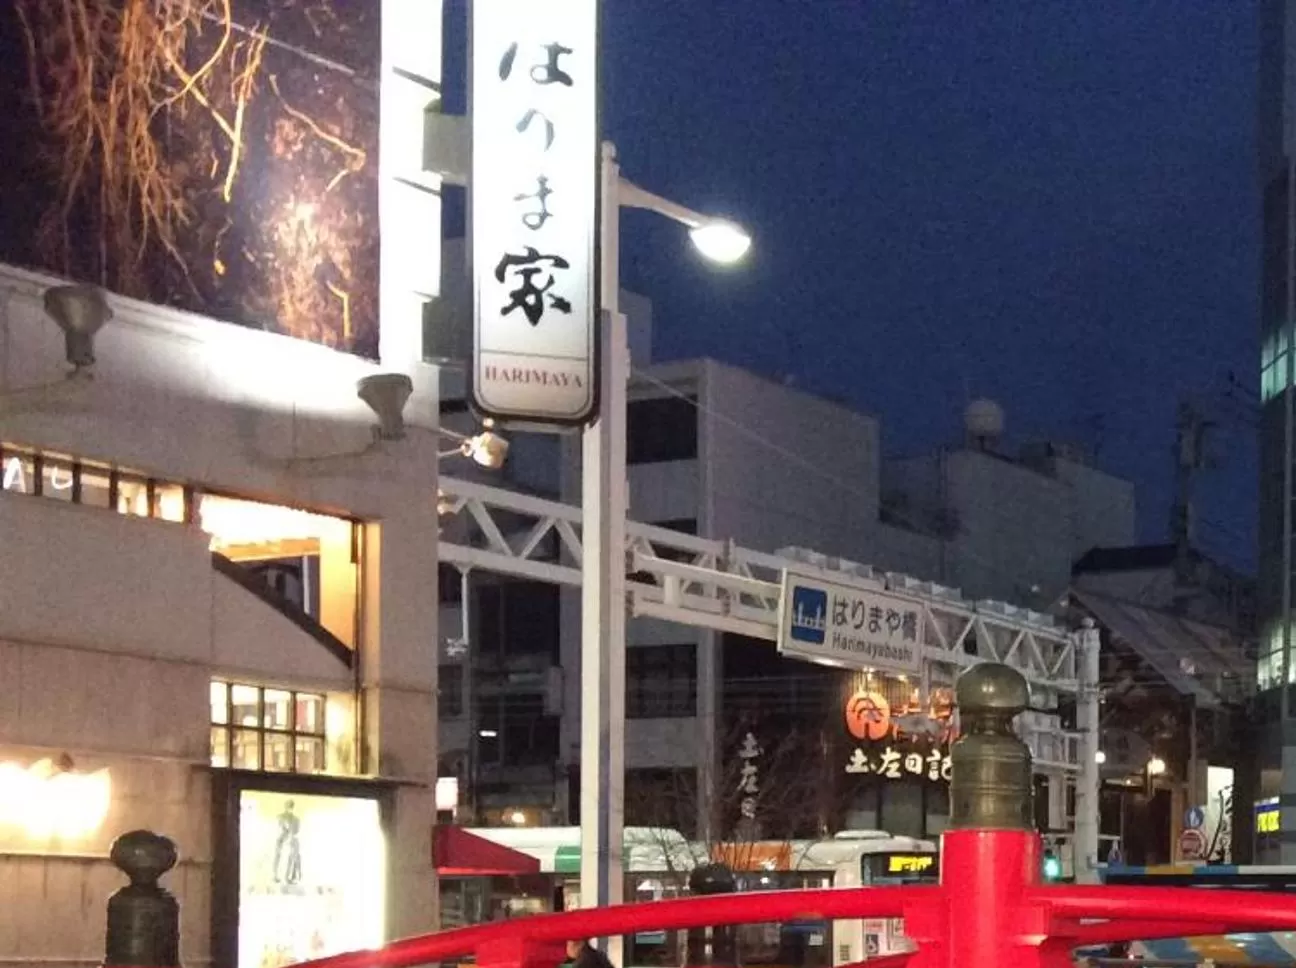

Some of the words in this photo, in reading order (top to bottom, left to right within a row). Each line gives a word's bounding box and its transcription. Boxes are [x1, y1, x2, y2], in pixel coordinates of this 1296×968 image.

[495, 41, 574, 327] はりま家
[485, 365, 583, 389] HARIMAYA
